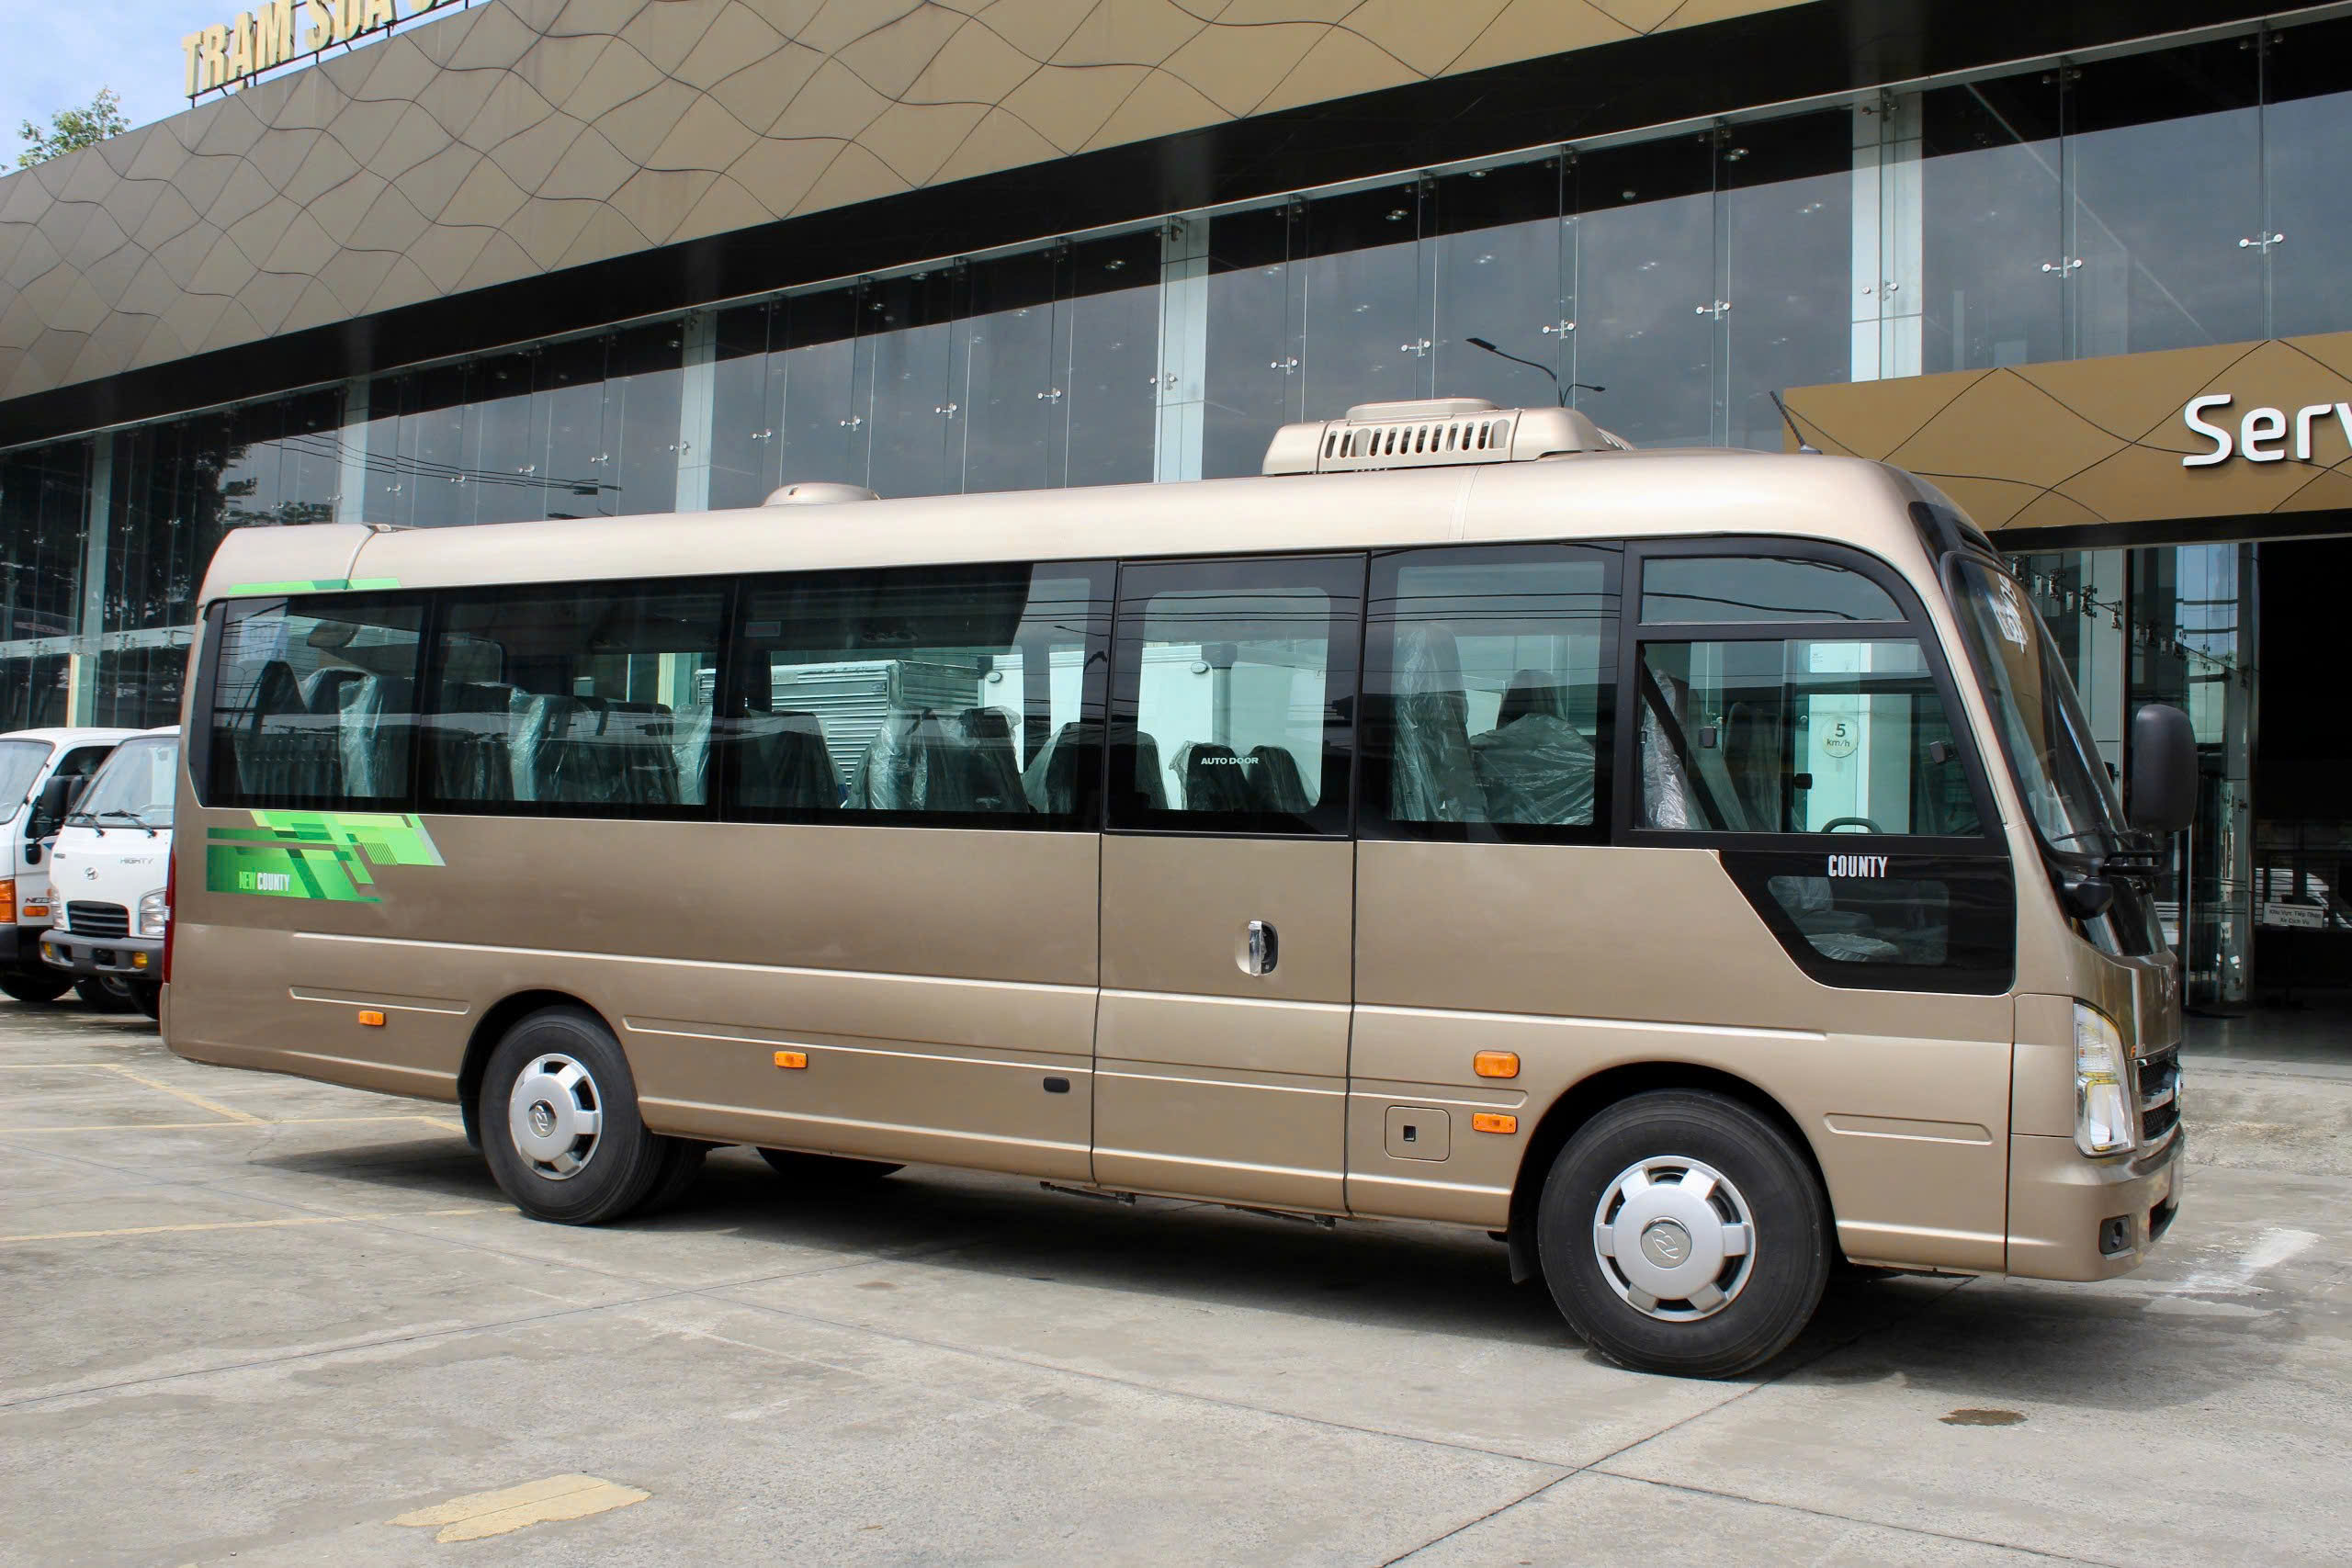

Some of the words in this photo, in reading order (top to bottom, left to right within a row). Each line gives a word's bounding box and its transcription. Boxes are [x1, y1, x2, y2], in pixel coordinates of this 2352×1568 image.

[1835, 723, 1846, 738] 5
[1826, 738, 1850, 748] km/h
[1201, 757, 1227, 765] AUTO
[1228, 757, 1259, 765] DOOR
[1827, 854, 1888, 878] COUNTY
[239, 871, 256, 890] NEW
[257, 872, 290, 892] COUNTY
